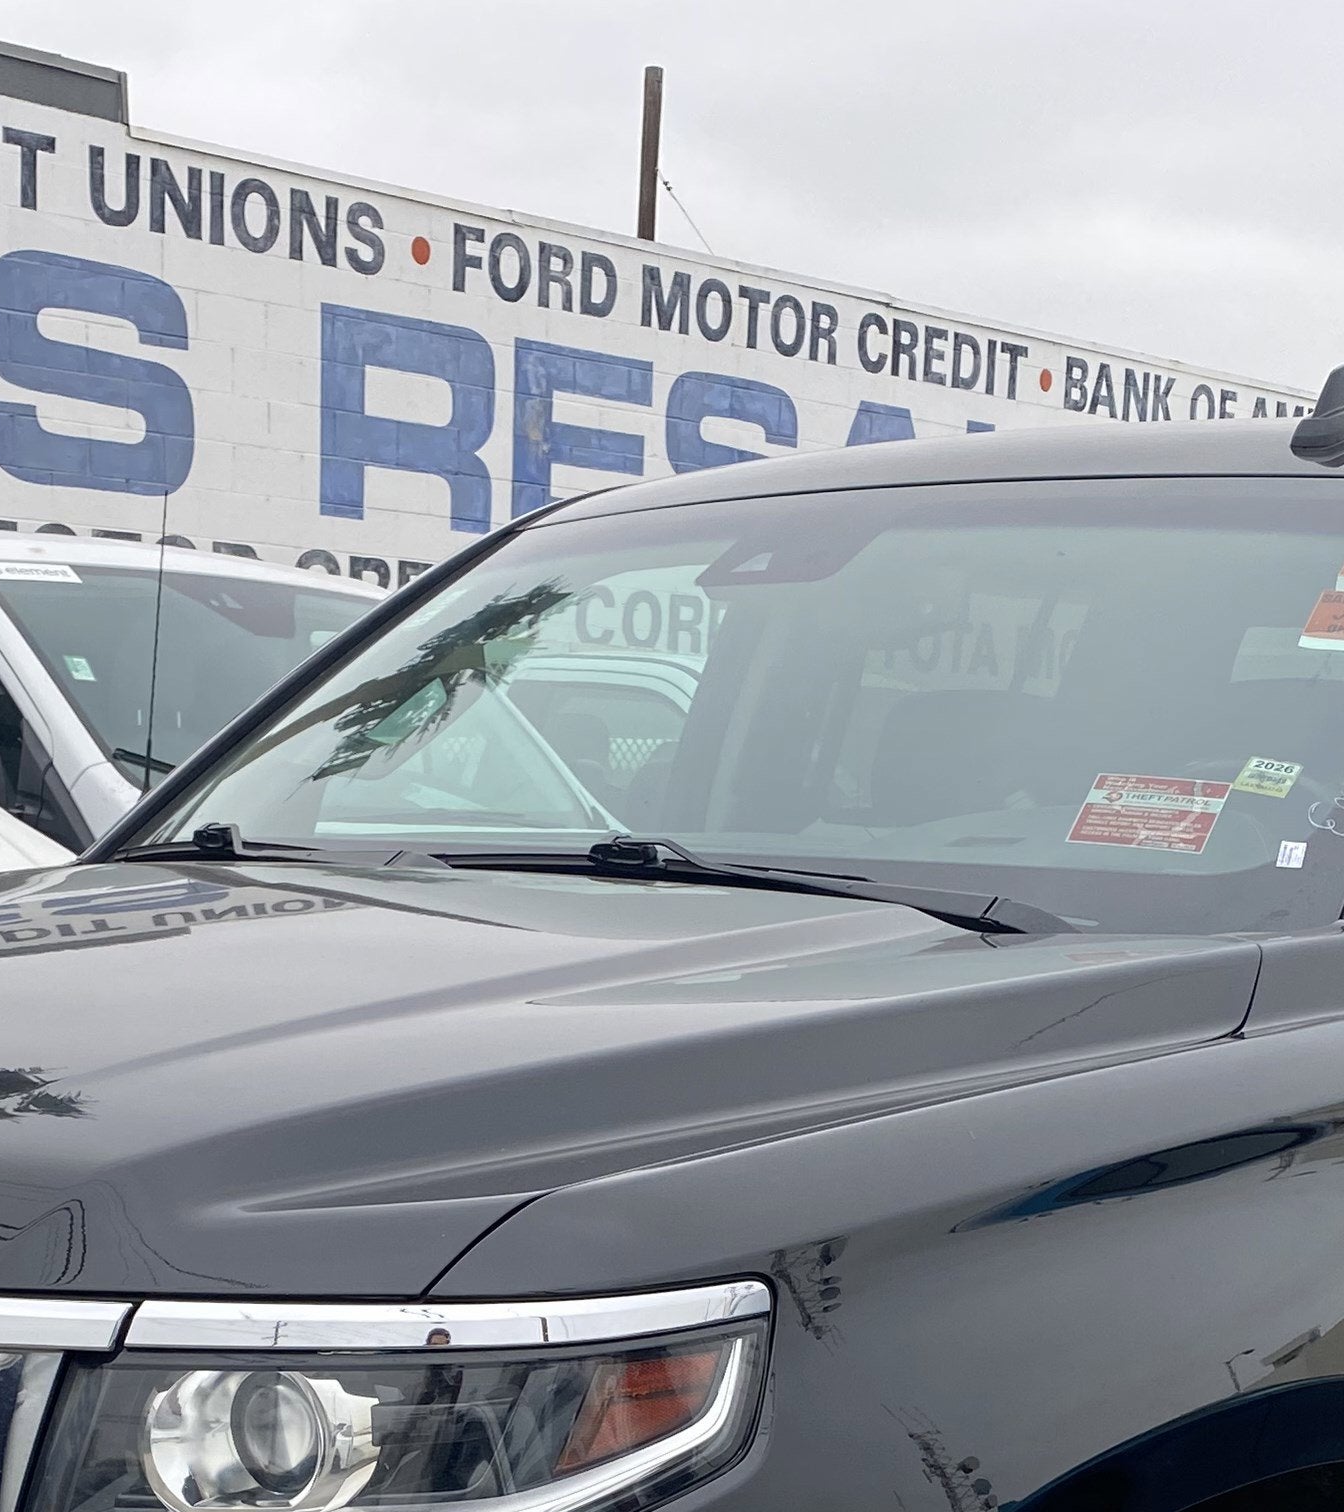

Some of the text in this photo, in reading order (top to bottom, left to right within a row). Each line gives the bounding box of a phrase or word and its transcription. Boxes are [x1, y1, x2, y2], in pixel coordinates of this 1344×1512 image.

[89, 145, 386, 276] UNIONS
[451, 222, 618, 319] FORD
[640, 263, 838, 365] MOTOR
[857, 312, 1029, 403] CREDIT
[1063, 356, 1176, 423] BANK
[1190, 384, 1238, 420] OF
[1254, 760, 1295, 774] 2026
